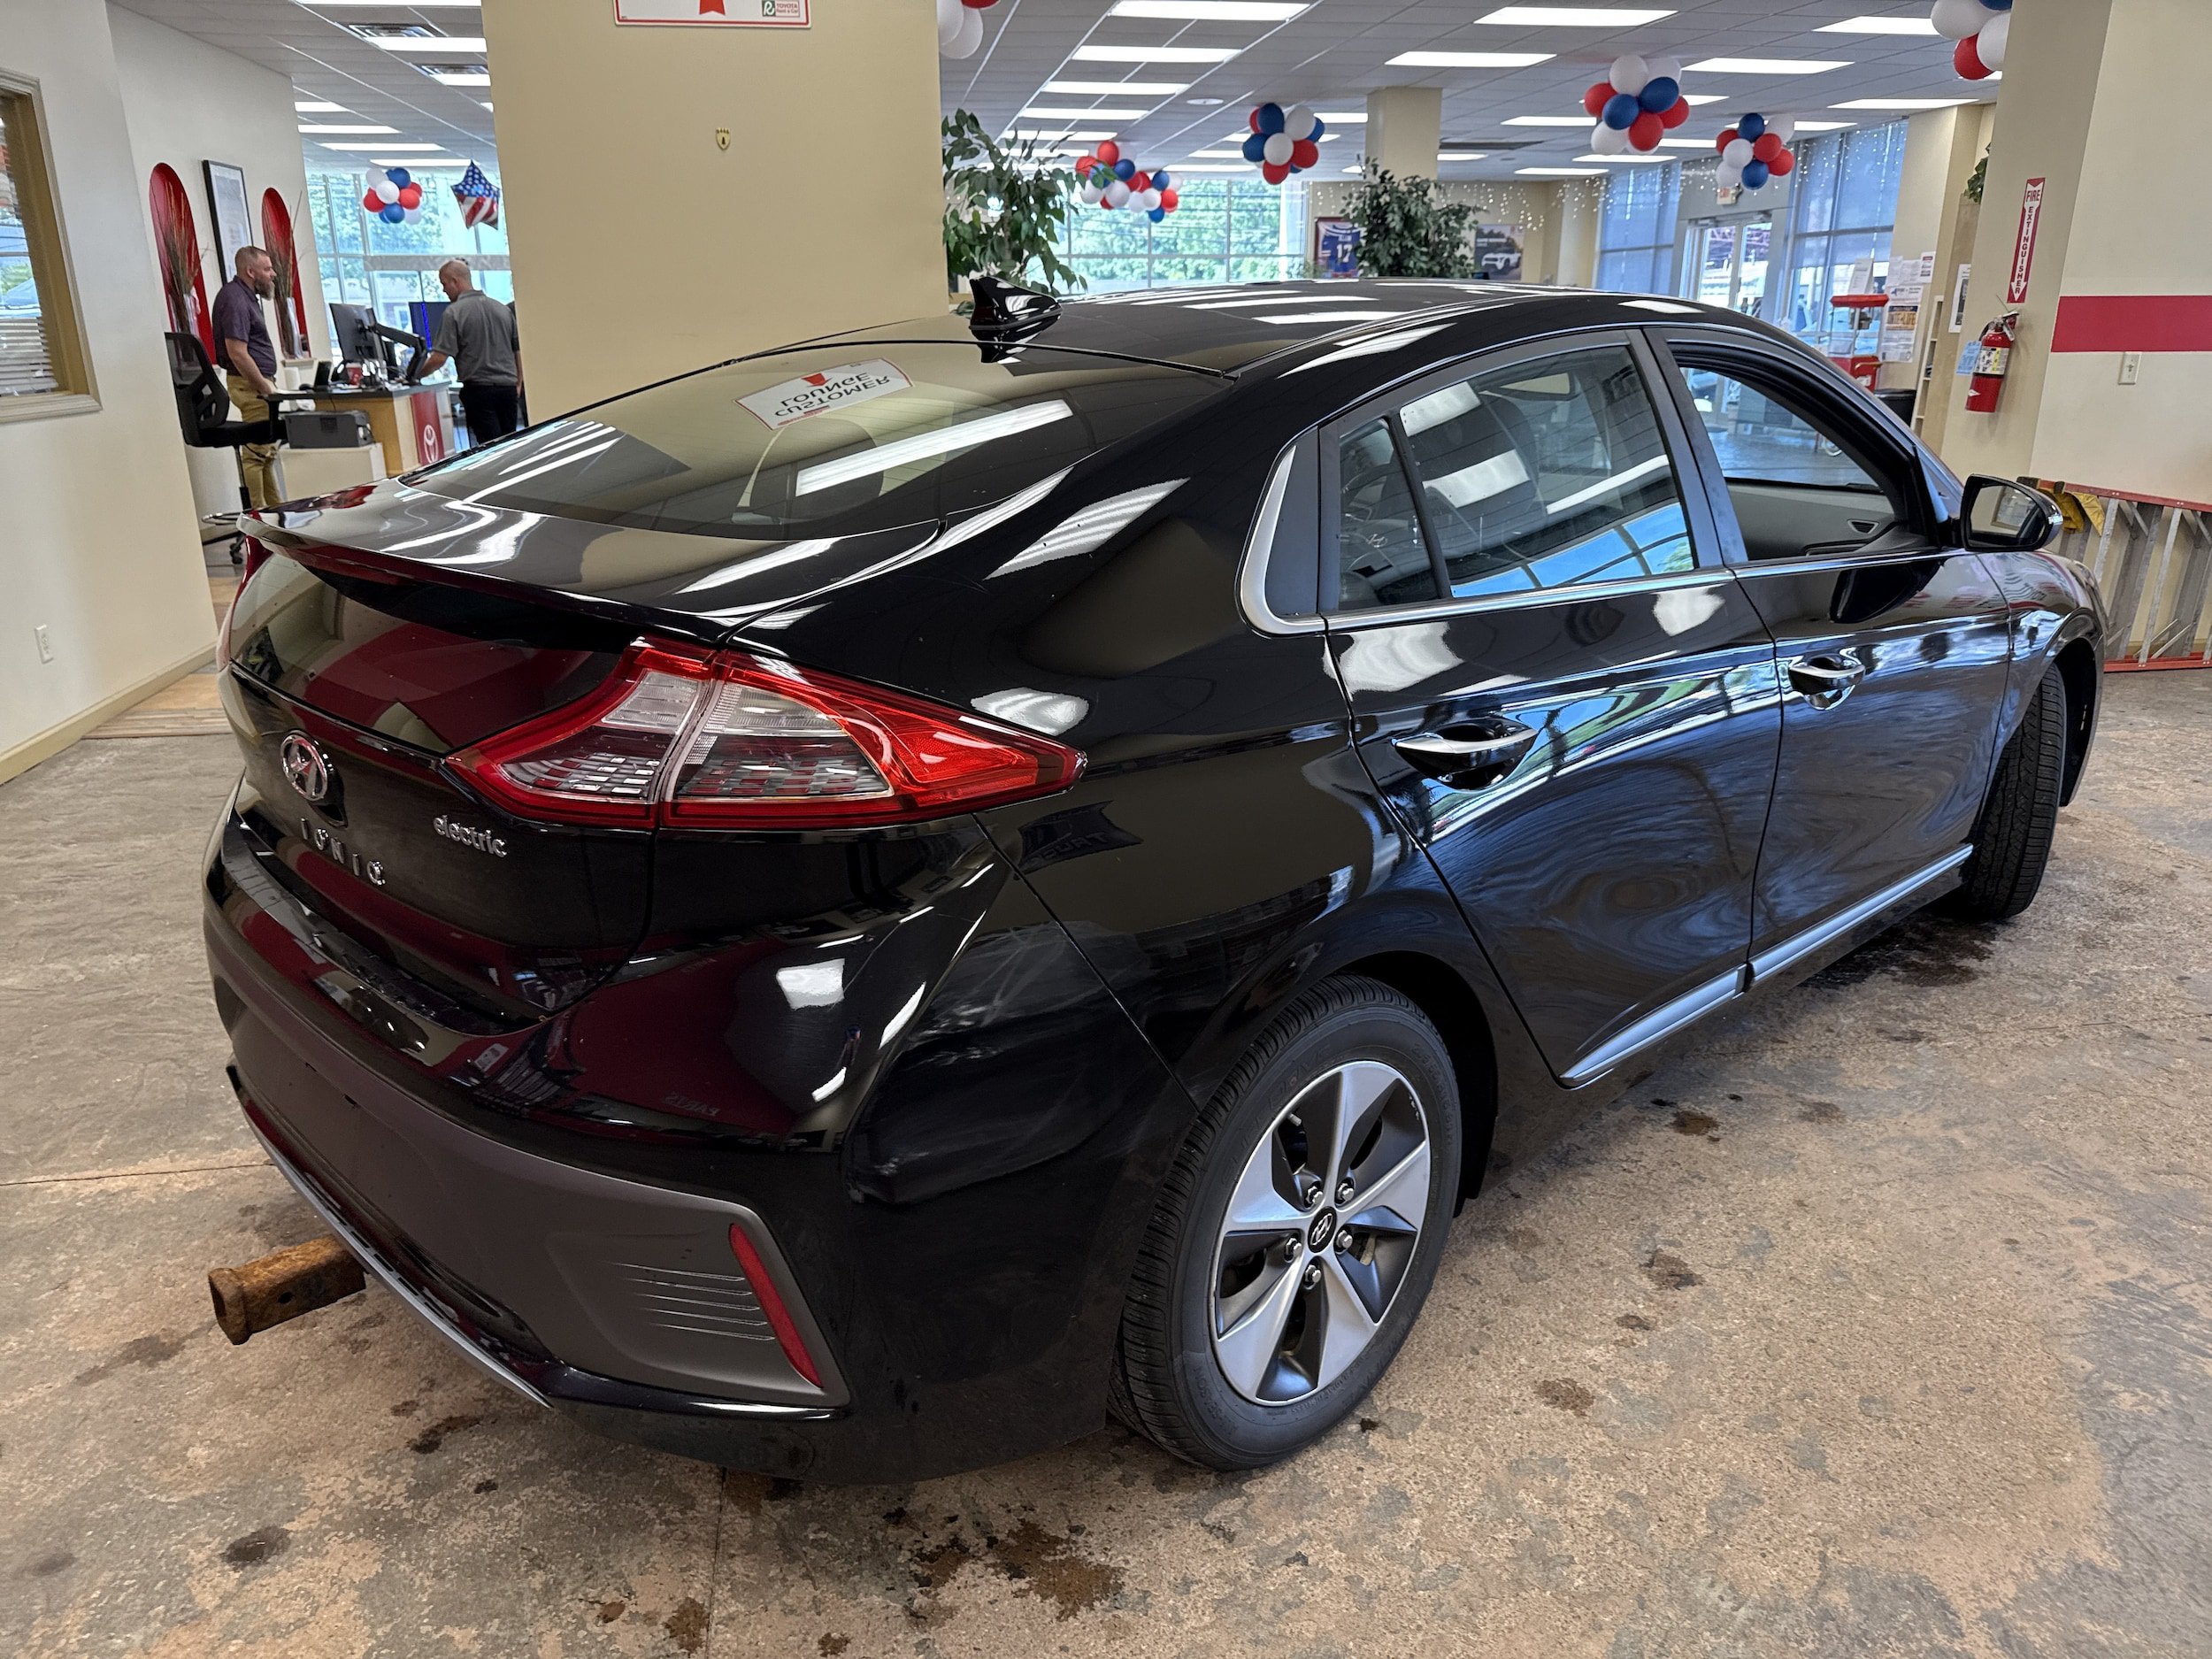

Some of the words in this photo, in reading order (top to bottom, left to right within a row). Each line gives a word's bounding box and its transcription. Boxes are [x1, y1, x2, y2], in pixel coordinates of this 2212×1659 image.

[2025, 189, 2041, 203] FIRE
[1336, 243, 1353, 263] 17
[2015, 206, 2033, 295] EXTINGUISHER
[433, 814, 508, 858] electric
